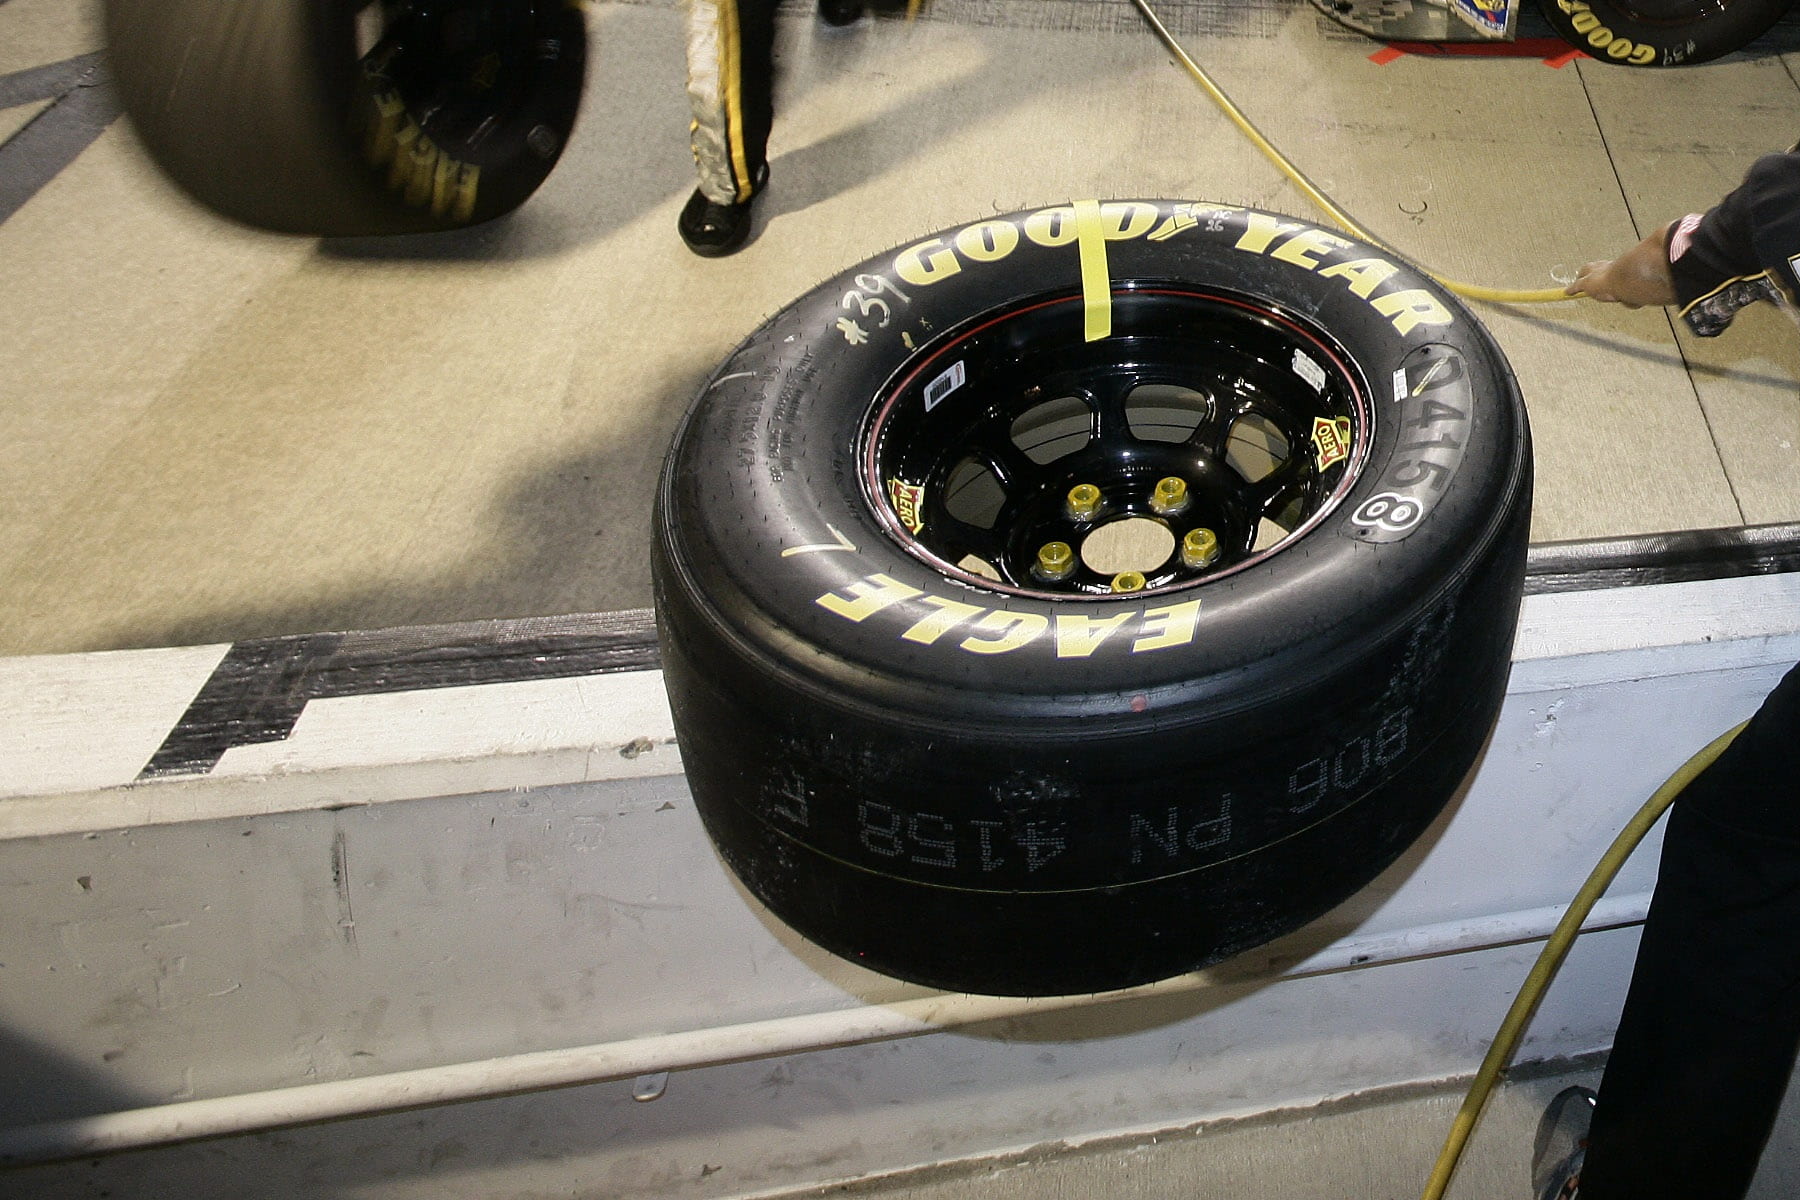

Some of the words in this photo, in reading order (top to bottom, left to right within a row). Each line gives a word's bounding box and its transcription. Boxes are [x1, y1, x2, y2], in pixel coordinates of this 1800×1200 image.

[894, 201, 1454, 338] GOODYEAR
[1317, 424, 1340, 458] AERO
[898, 487, 915, 529] AERO
[816, 572, 1202, 659] EAGLE
[858, 799, 1067, 874] 4158
[1129, 792, 1232, 866] PN
